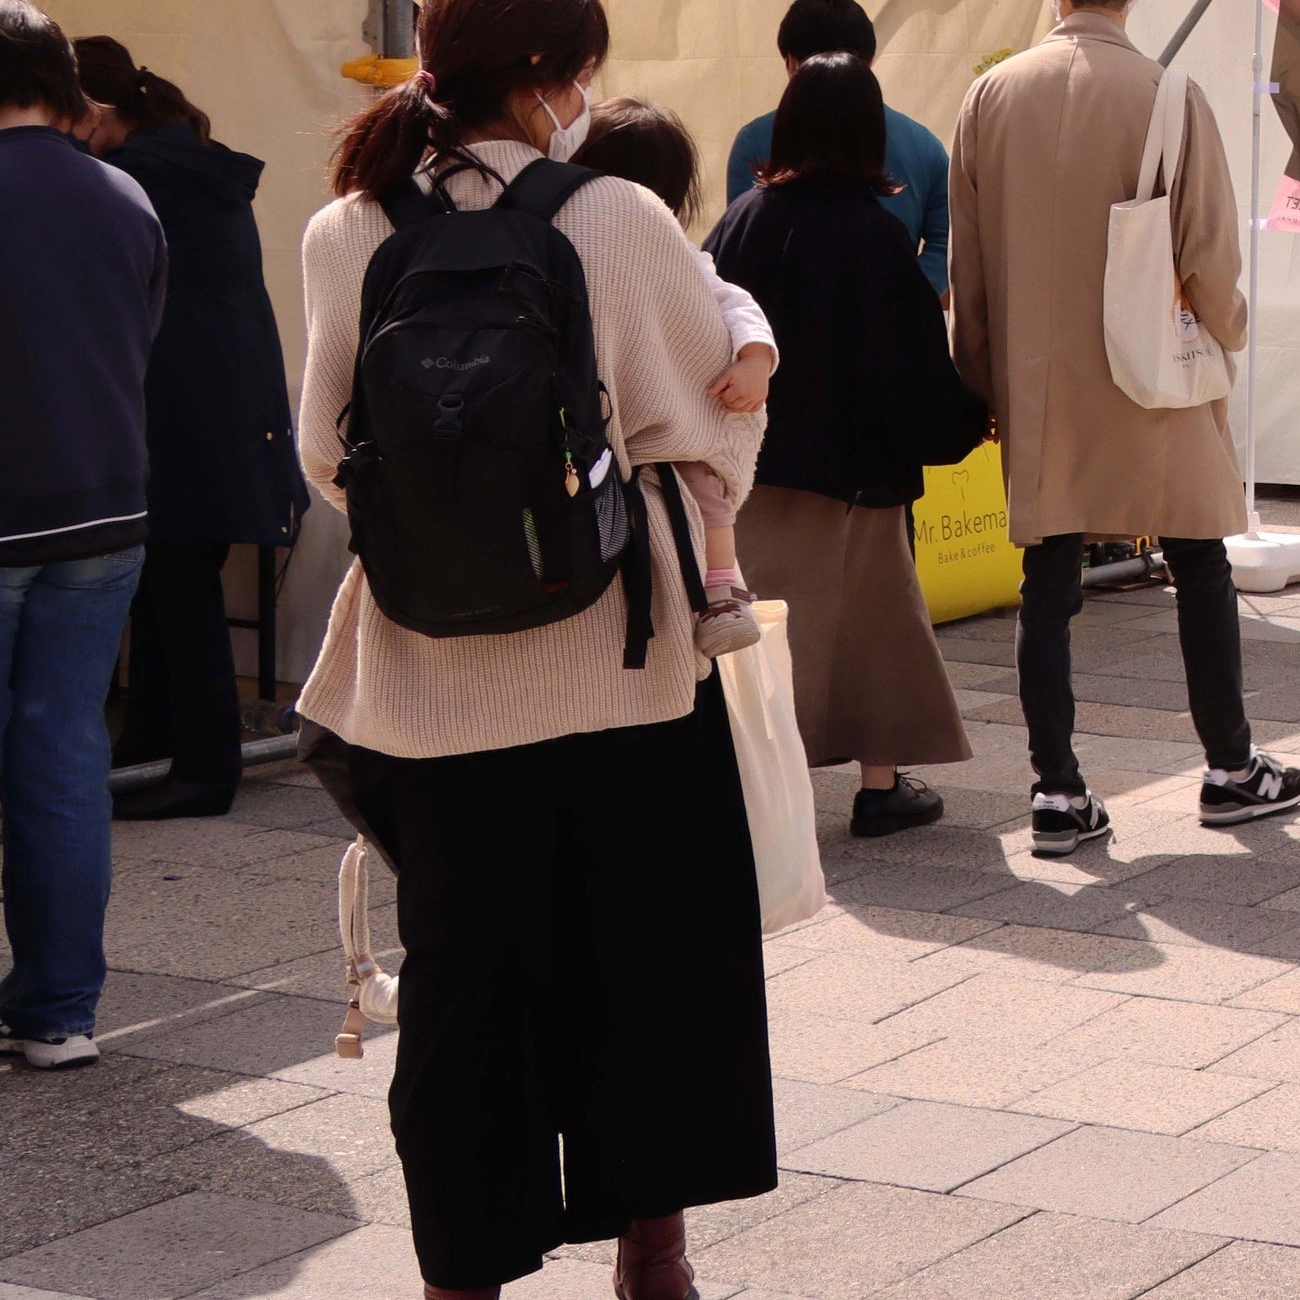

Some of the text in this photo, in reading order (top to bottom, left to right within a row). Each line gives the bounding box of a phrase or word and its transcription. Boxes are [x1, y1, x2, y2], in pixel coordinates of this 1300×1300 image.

[436, 356, 489, 370] Columbia
[941, 511, 1007, 541] Bakema
[937, 543, 996, 565] Bake&coffee
